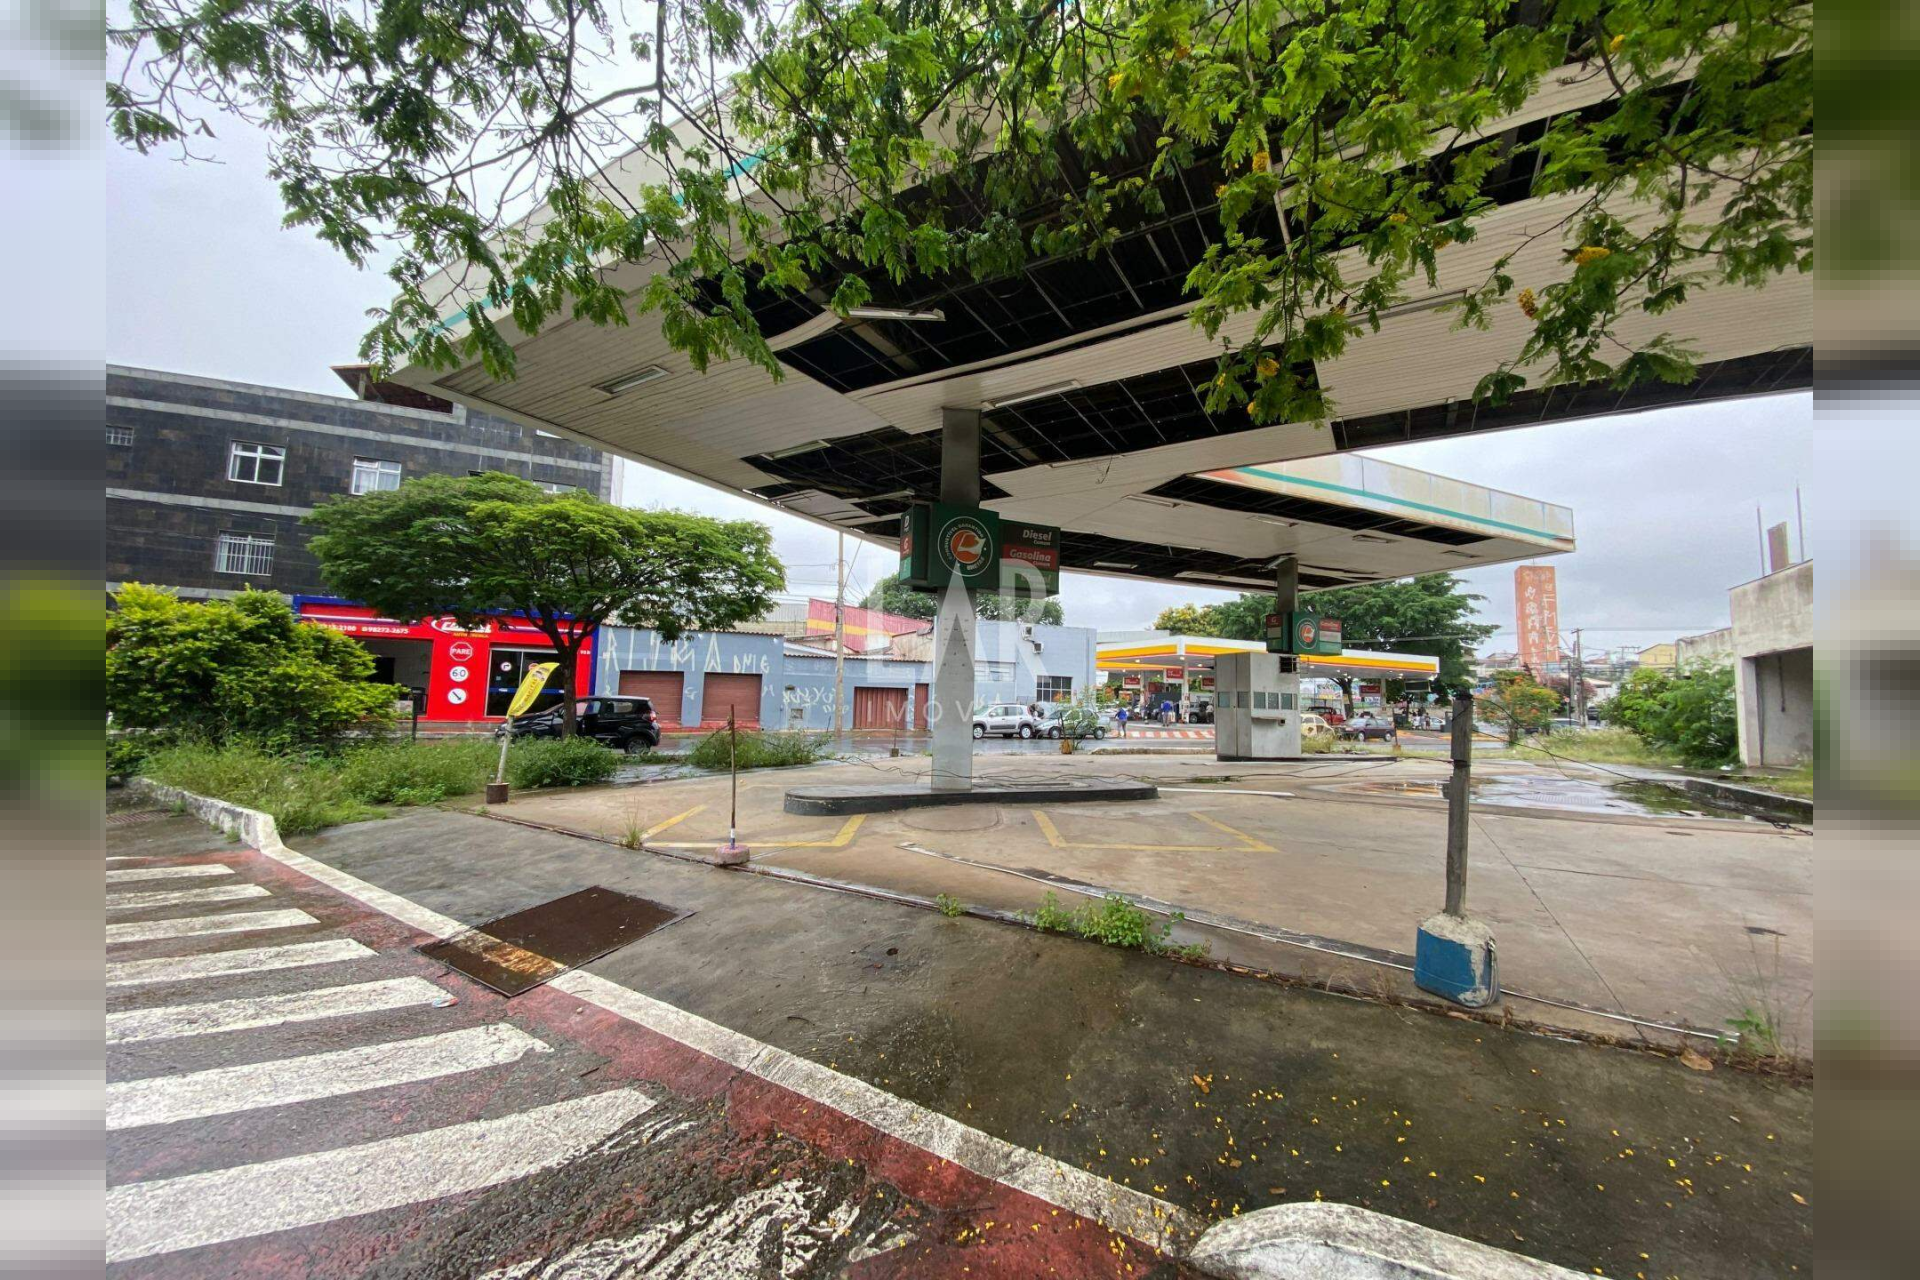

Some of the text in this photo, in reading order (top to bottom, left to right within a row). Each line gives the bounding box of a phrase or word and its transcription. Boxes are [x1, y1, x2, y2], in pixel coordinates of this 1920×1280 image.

[1022, 529, 1053, 541] Diesel
[1010, 549, 1052, 561] Gasolina
[450, 647, 471, 655] PARE
[452, 668, 467, 678] 60
